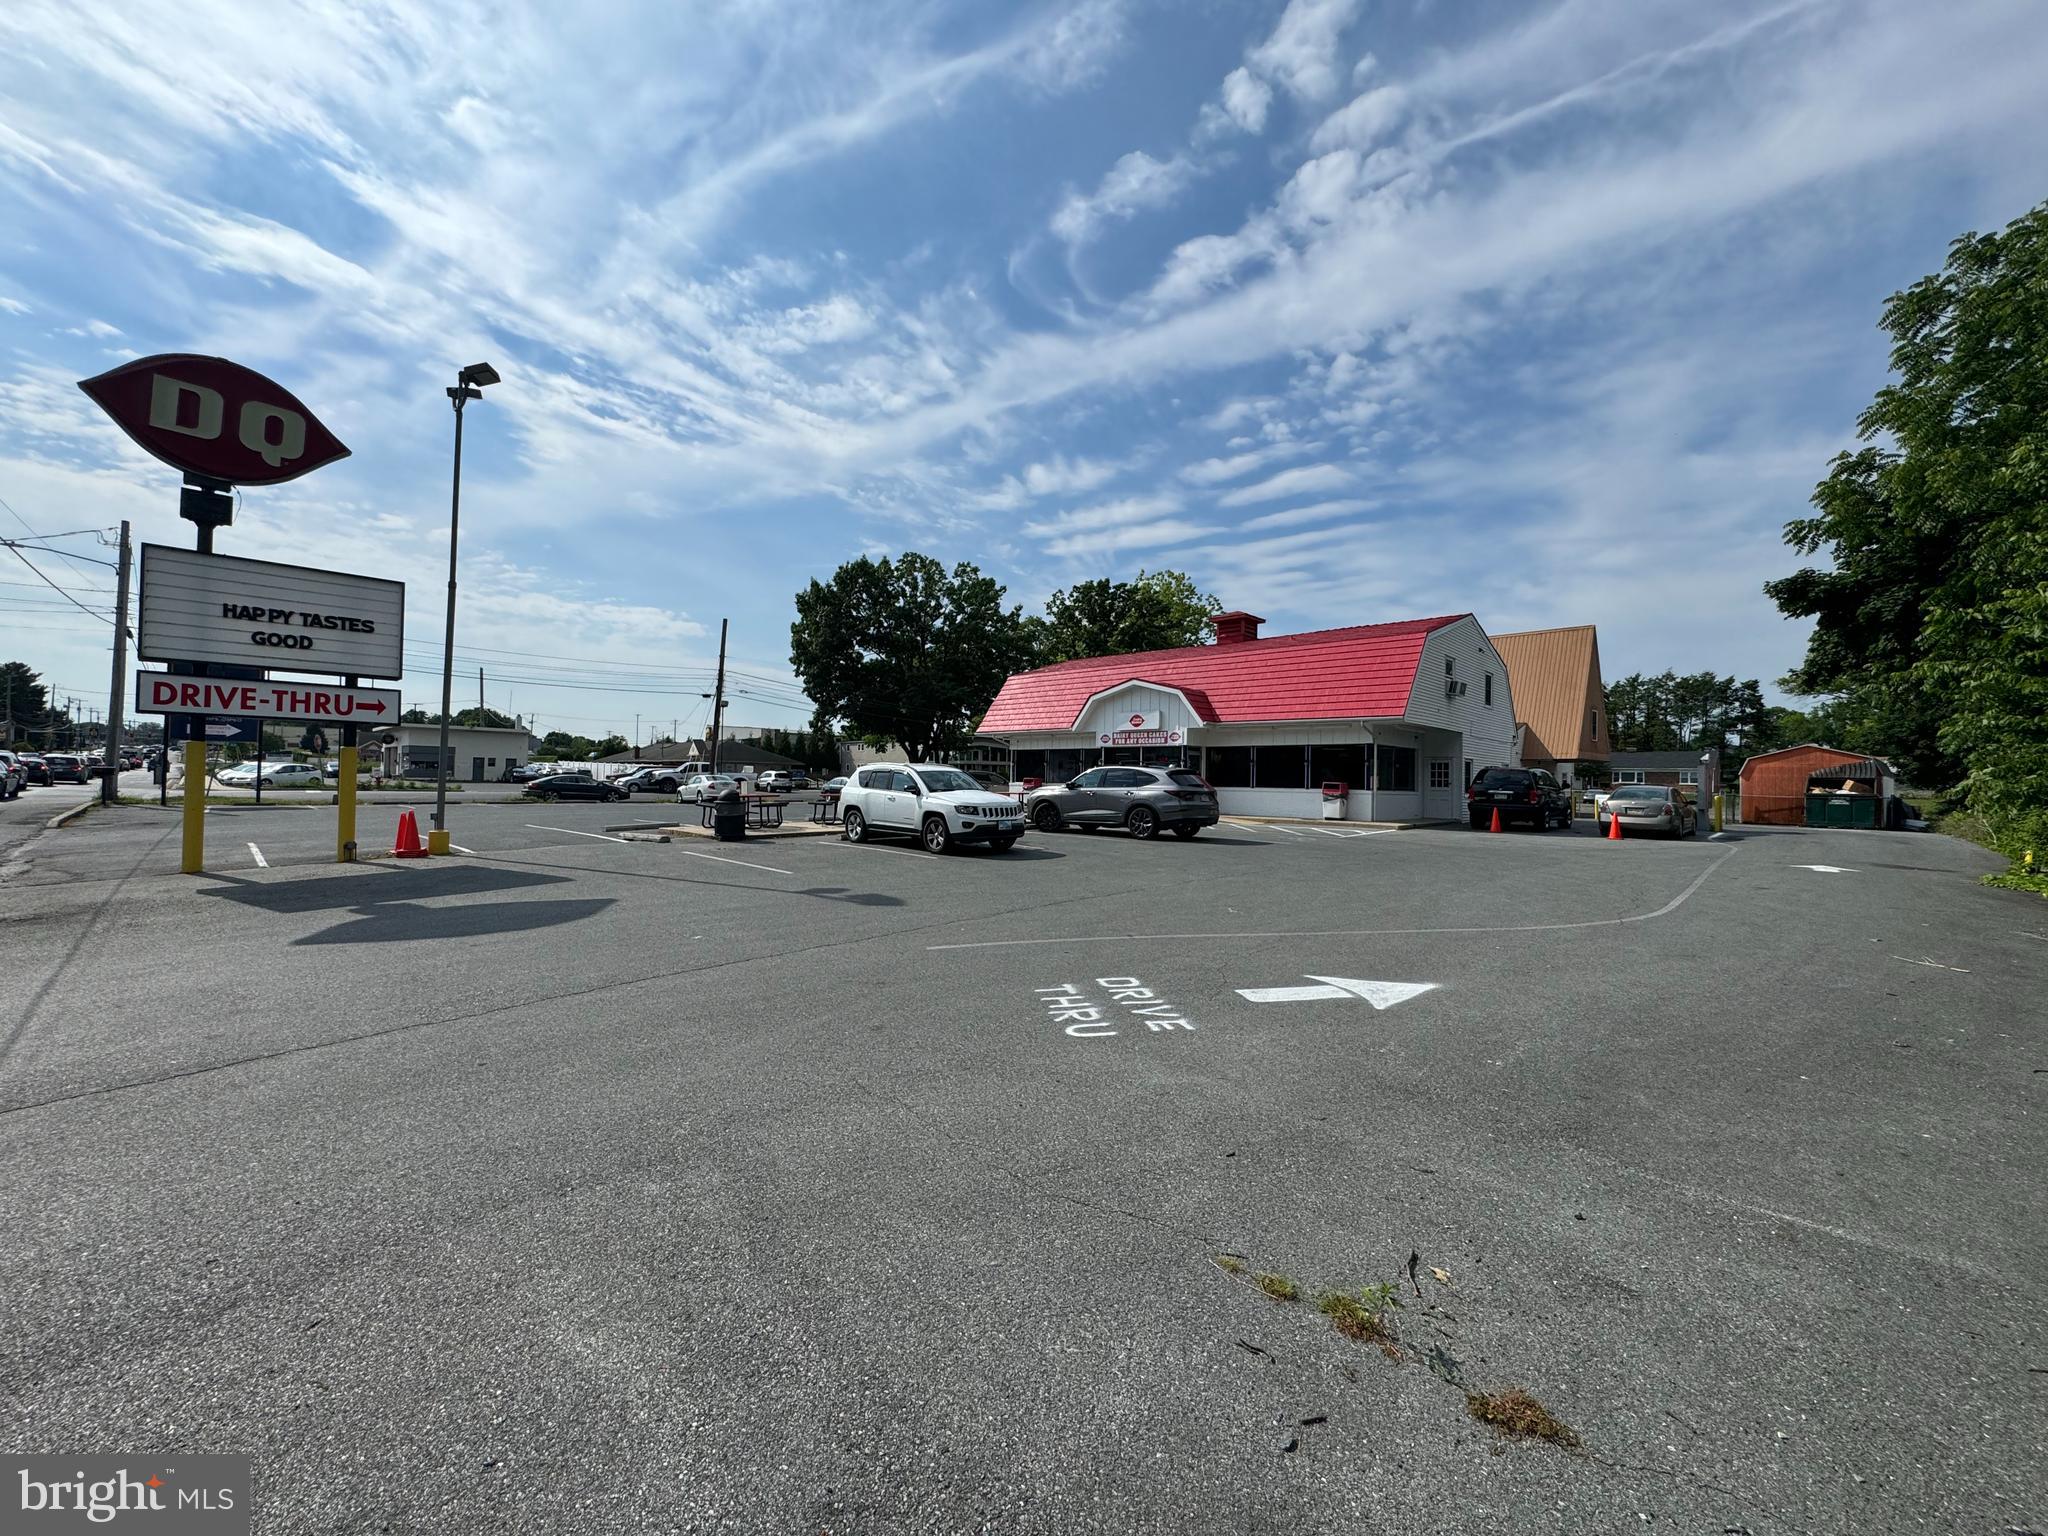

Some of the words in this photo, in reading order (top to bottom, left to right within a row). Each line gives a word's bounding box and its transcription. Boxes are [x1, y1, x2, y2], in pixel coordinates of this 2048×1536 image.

[149, 373, 306, 467] DQ
[222, 603, 295, 626] HAPPY
[299, 611, 375, 634] TASTES
[251, 631, 314, 650] GOOD
[152, 681, 354, 716] DRIVE-THRU
[1034, 983, 1119, 1038] THRU
[1095, 977, 1196, 1032] DRIVE
